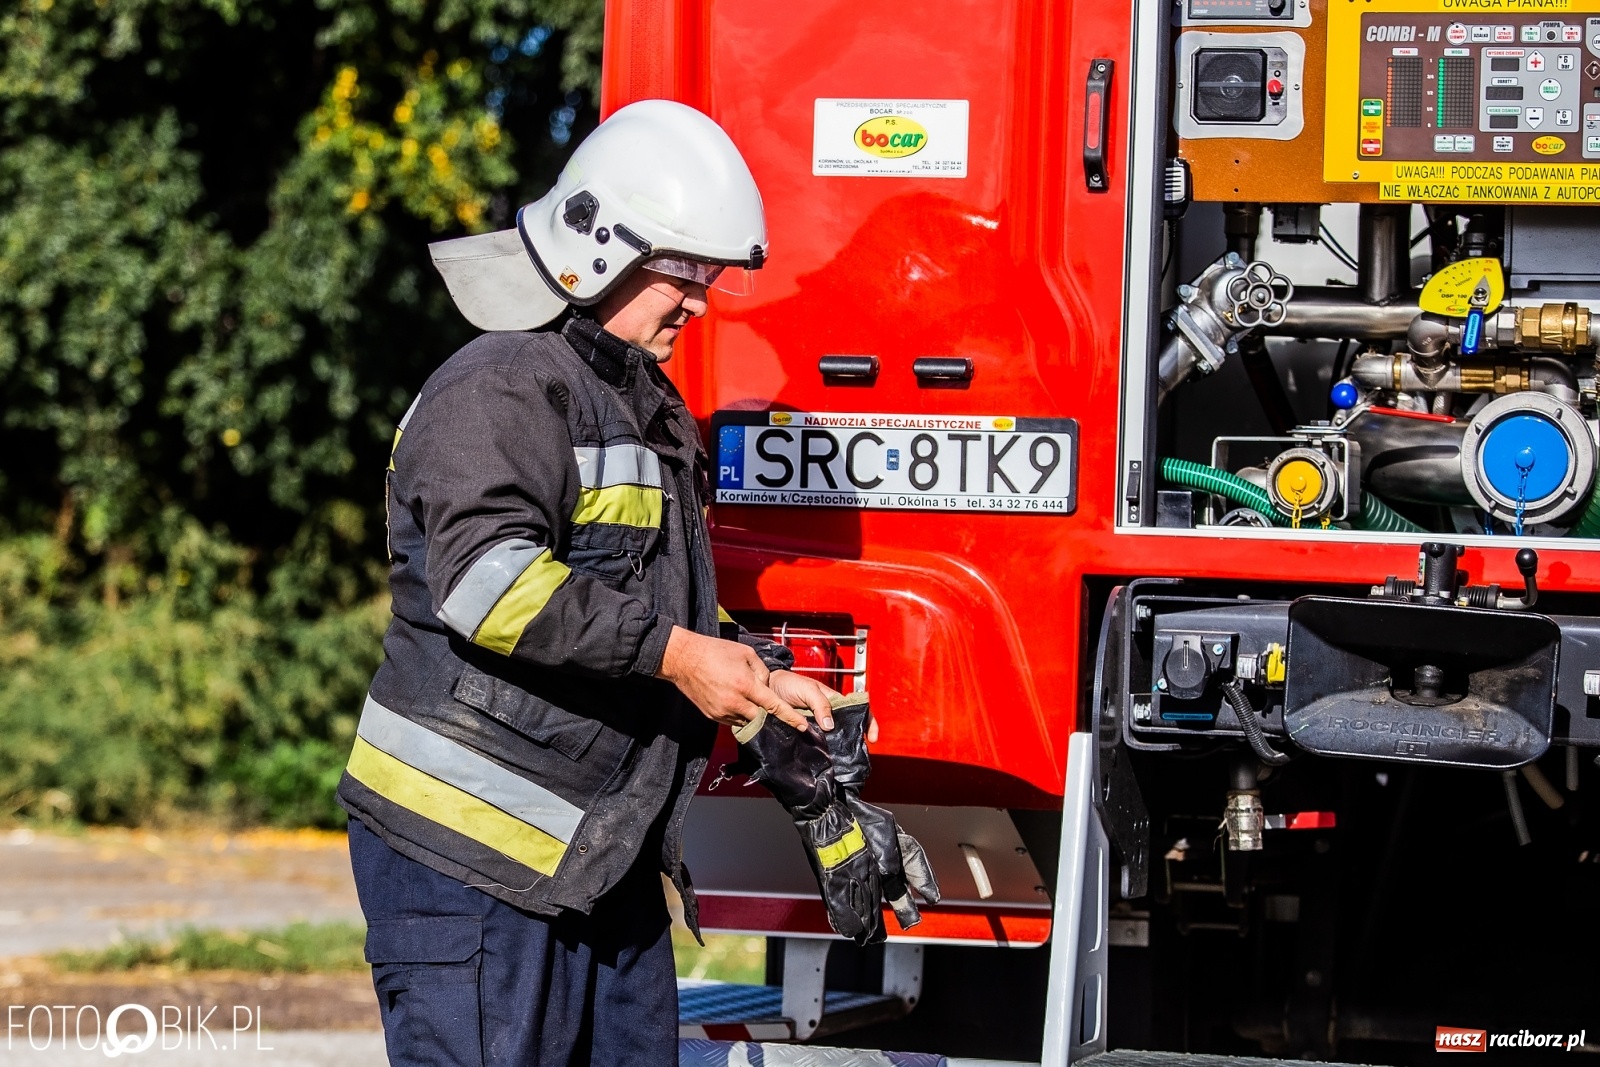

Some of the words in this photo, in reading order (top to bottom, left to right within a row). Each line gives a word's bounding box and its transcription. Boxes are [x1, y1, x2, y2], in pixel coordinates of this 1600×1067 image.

[1366, 26, 1416, 42] COMBI
[1426, 26, 1441, 42] M
[862, 130, 923, 147] bocar
[1396, 166, 1444, 178] UWAGA!!!
[1452, 166, 1503, 180] PODCZAS
[1509, 167, 1575, 180] PODAWANIA
[1581, 168, 1600, 180] PIA
[1384, 185, 1400, 197] NIE
[1407, 184, 1460, 198] WŁĄCZAĆ
[1466, 186, 1538, 198] TANKOWANIA
[1544, 186, 1550, 198] Z
[805, 416, 866, 426] NADWOZIA
[871, 418, 982, 429] SPECJALISTYCZNE
[755, 428, 885, 490] SRC
[908, 433, 1060, 494] 8TK9
[720, 466, 740, 481] PL
[720, 491, 779, 503] Korwinów
[781, 493, 869, 508] k/Częstochowy
[880, 497, 894, 505] ul.
[898, 496, 938, 506] Okólna
[944, 498, 956, 507] 15
[967, 499, 985, 508] tel.
[989, 500, 1003, 508] 34
[1007, 500, 1020, 508] 32
[1025, 500, 1038, 509] 76
[1042, 500, 1063, 509] 444
[1328, 716, 1504, 742] ROCKINGER
